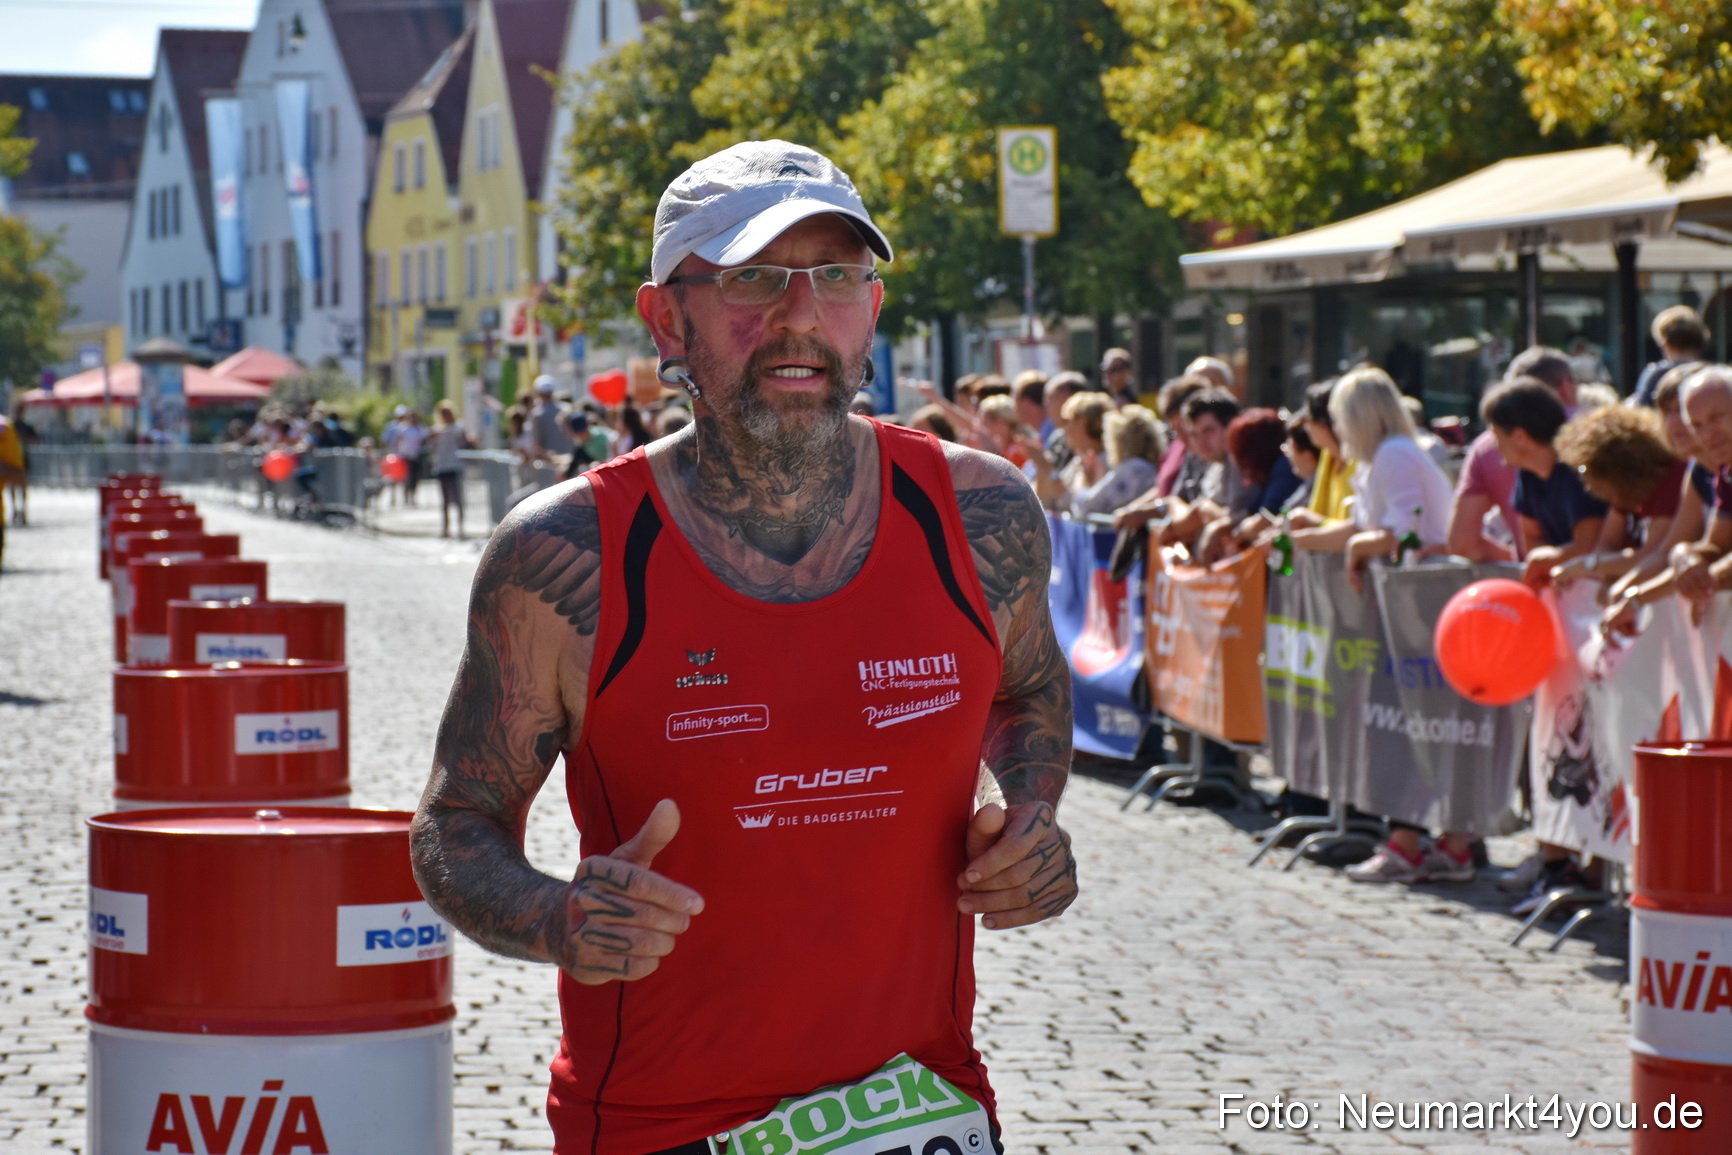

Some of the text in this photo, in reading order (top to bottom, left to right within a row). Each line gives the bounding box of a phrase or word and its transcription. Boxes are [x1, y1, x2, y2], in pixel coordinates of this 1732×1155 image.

[858, 652, 957, 680] HEINLOTH
[861, 674, 960, 692] CNC-Fertigungstechnik
[861, 690, 961, 726] Präzisionsteile
[754, 765, 888, 794] Gruber
[778, 807, 897, 827] DIE BADGESTALTER
